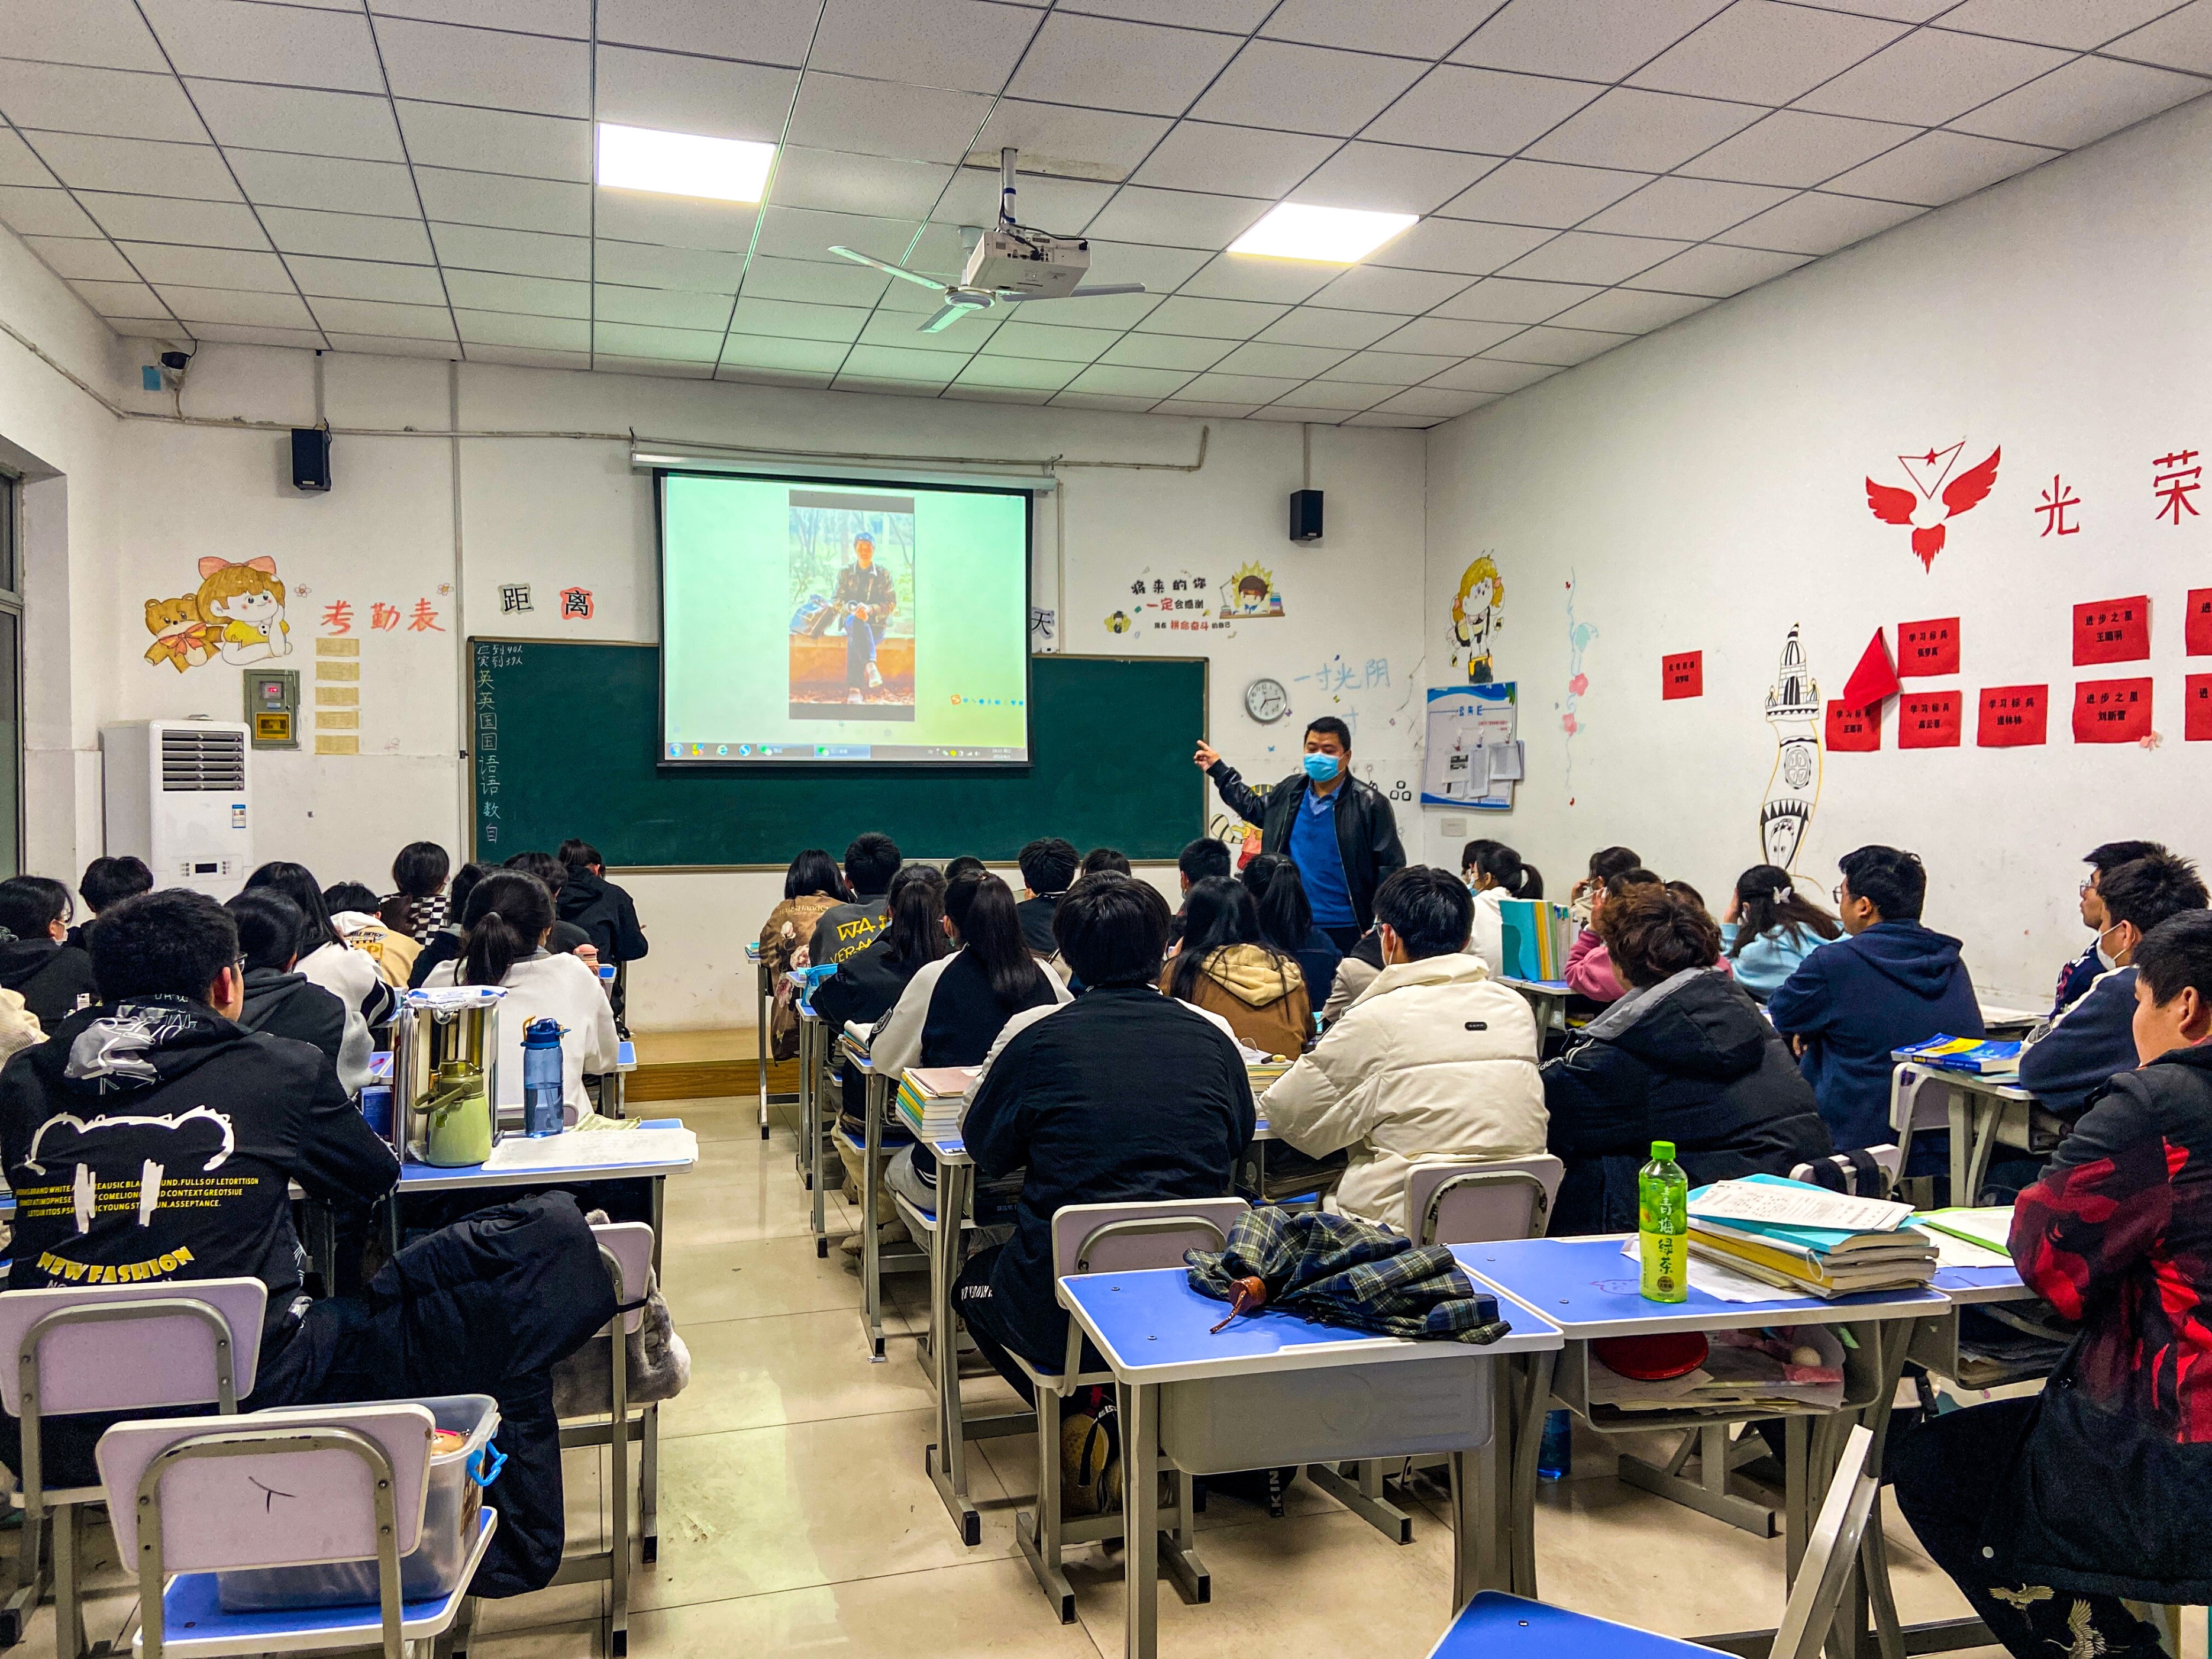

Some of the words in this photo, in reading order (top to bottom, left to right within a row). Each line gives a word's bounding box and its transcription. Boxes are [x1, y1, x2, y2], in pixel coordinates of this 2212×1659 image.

[1131, 577, 1206, 595] 将来的你
[1146, 598, 1203, 611] 一定会感谢
[321, 598, 446, 636] 考勤表
[1031, 611, 1052, 636] 天
[2085, 610, 2133, 626] 进步之星
[1294, 658, 1391, 692] 一寸光阴
[1989, 698, 2035, 709] 学习标兵
[2085, 691, 2138, 704] 进步之星
[103, 1203, 130, 1212] YOUNG
[1658, 1186, 1674, 1274] 青梅绿茶
[36, 1251, 89, 1280] NEW
[87, 1245, 195, 1283] FASHION
